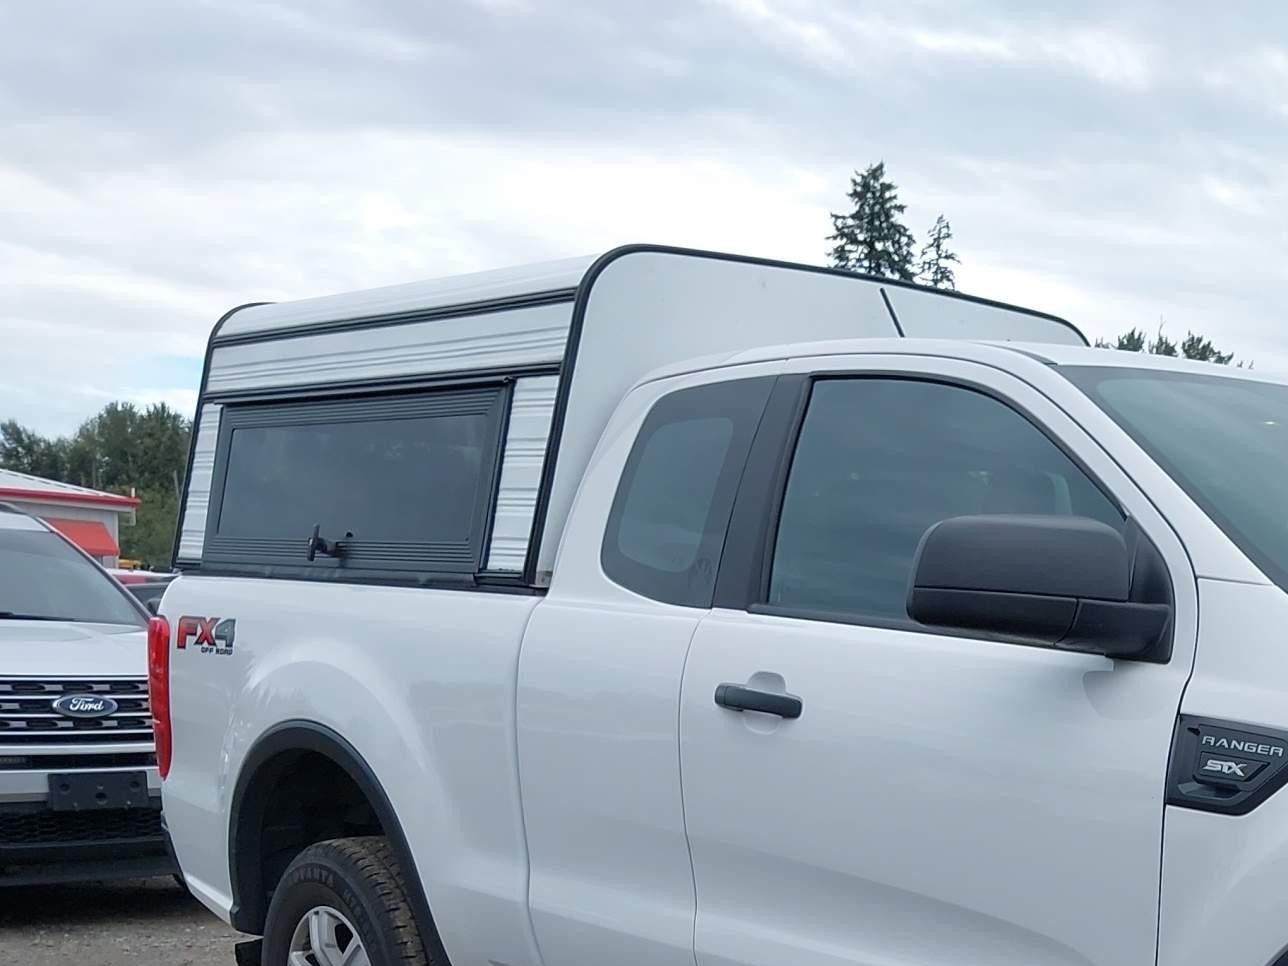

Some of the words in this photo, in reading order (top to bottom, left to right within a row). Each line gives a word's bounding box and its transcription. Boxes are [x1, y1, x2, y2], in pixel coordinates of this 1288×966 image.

[177, 615, 236, 648] FX4
[69, 697, 104, 711] Ford
[1201, 735, 1284, 757] RANGER
[1202, 760, 1247, 776] STX
